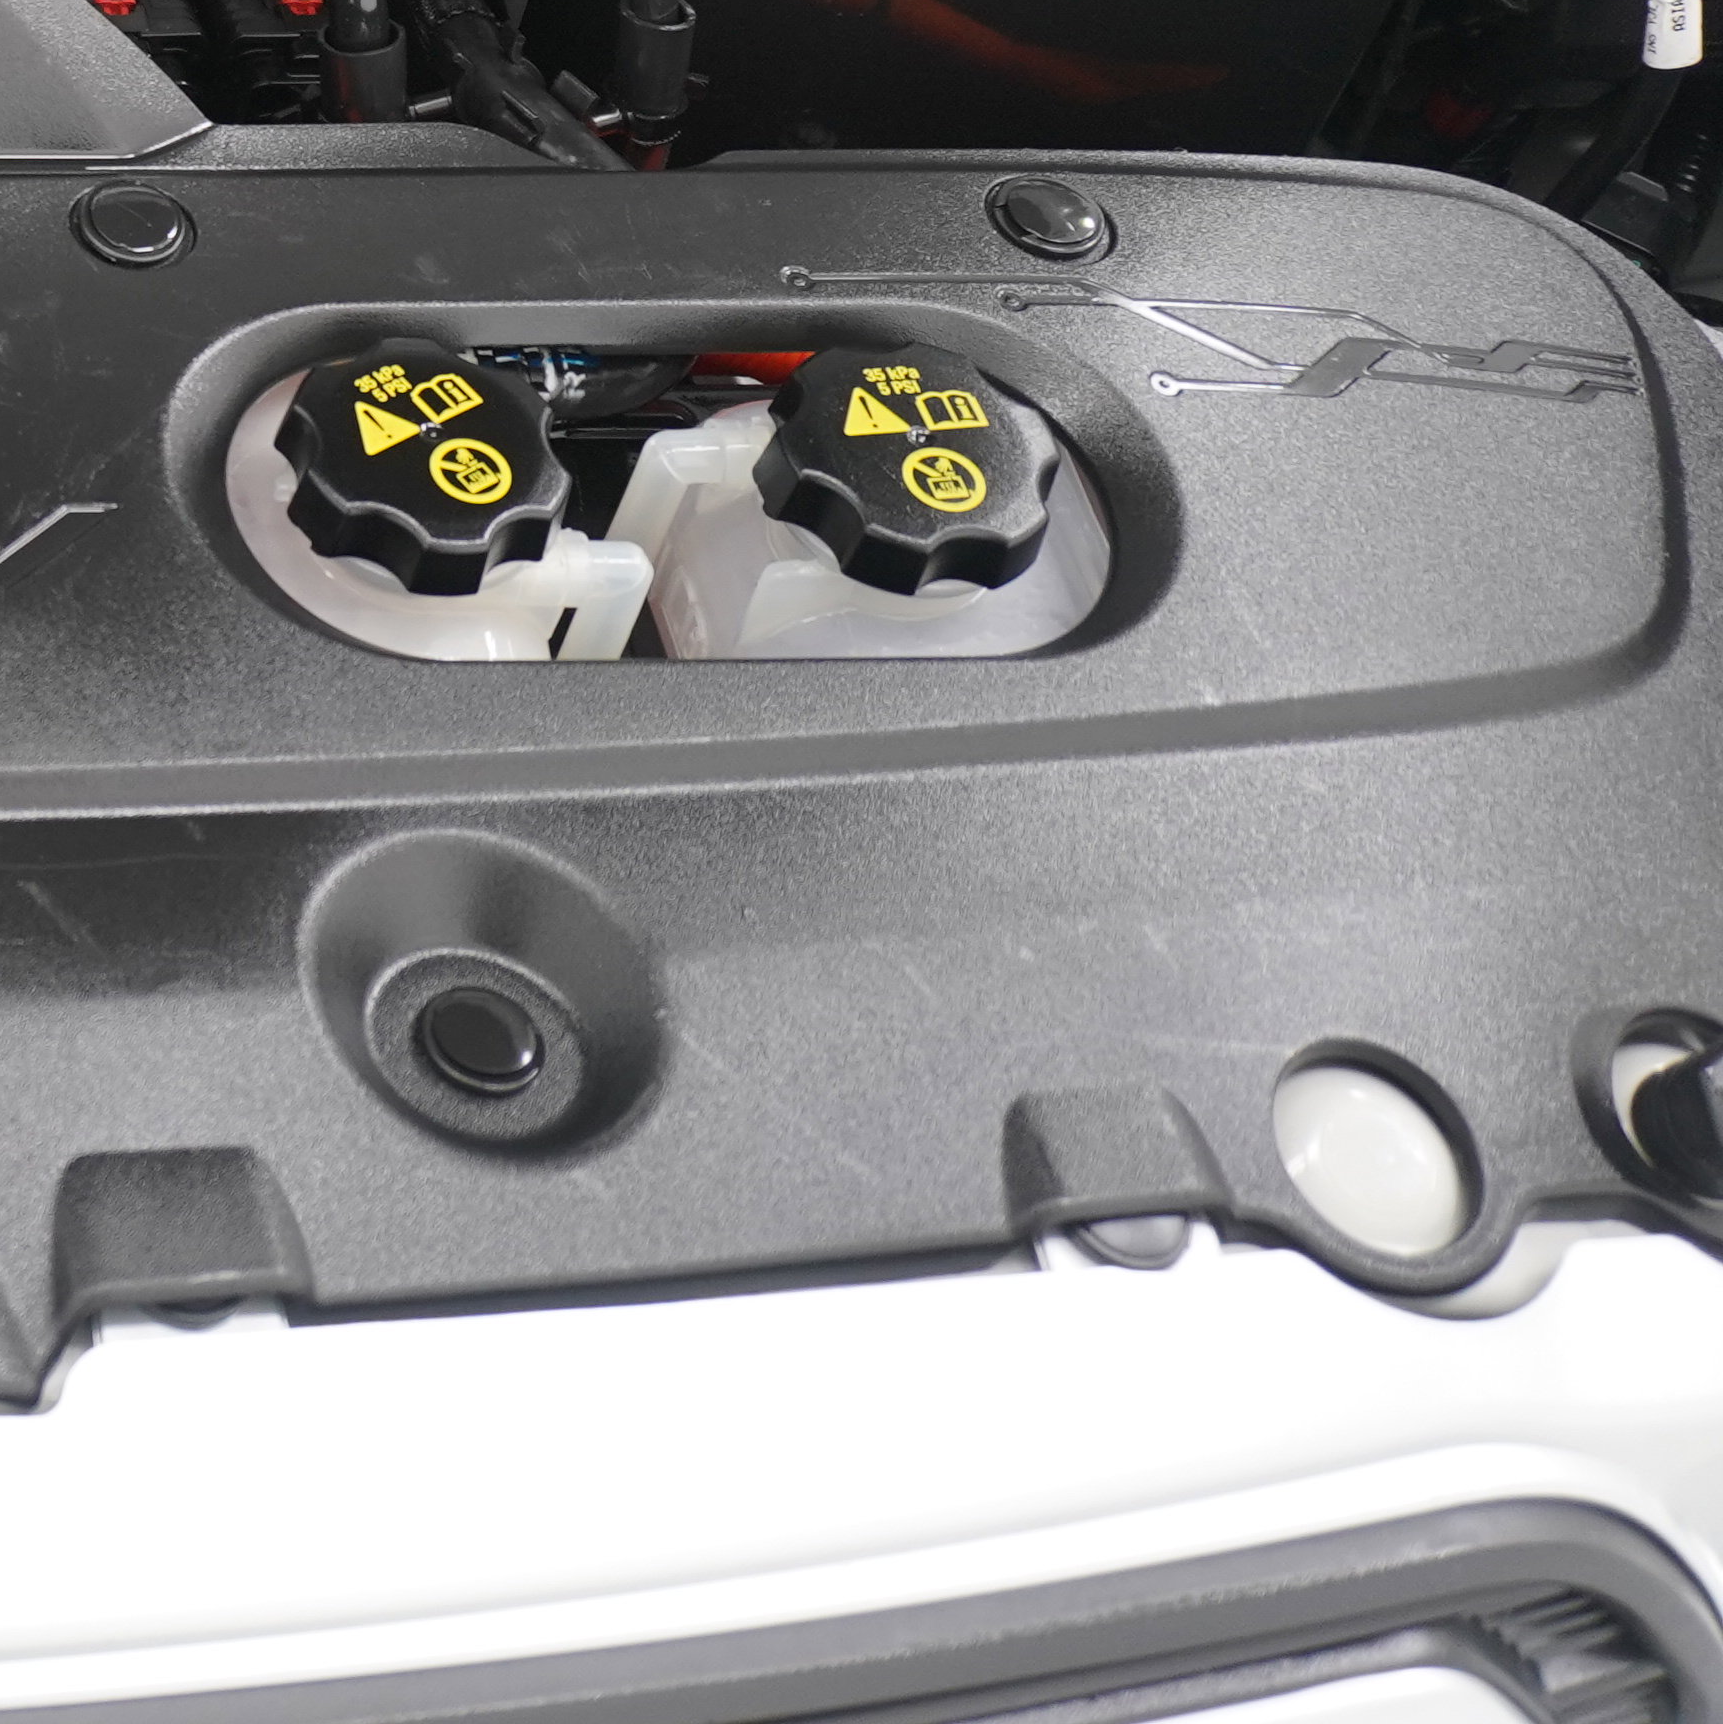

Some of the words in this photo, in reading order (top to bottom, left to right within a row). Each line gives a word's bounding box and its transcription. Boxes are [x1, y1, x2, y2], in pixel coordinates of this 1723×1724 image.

[354, 375, 378, 393] 35
[371, 364, 406, 384] kPa
[862, 368, 886, 382] 35
[885, 366, 920, 380] kPa
[371, 388, 389, 403] 5
[382, 377, 413, 398] PSI
[876, 382, 891, 396] 5
[890, 380, 921, 394] PSI
